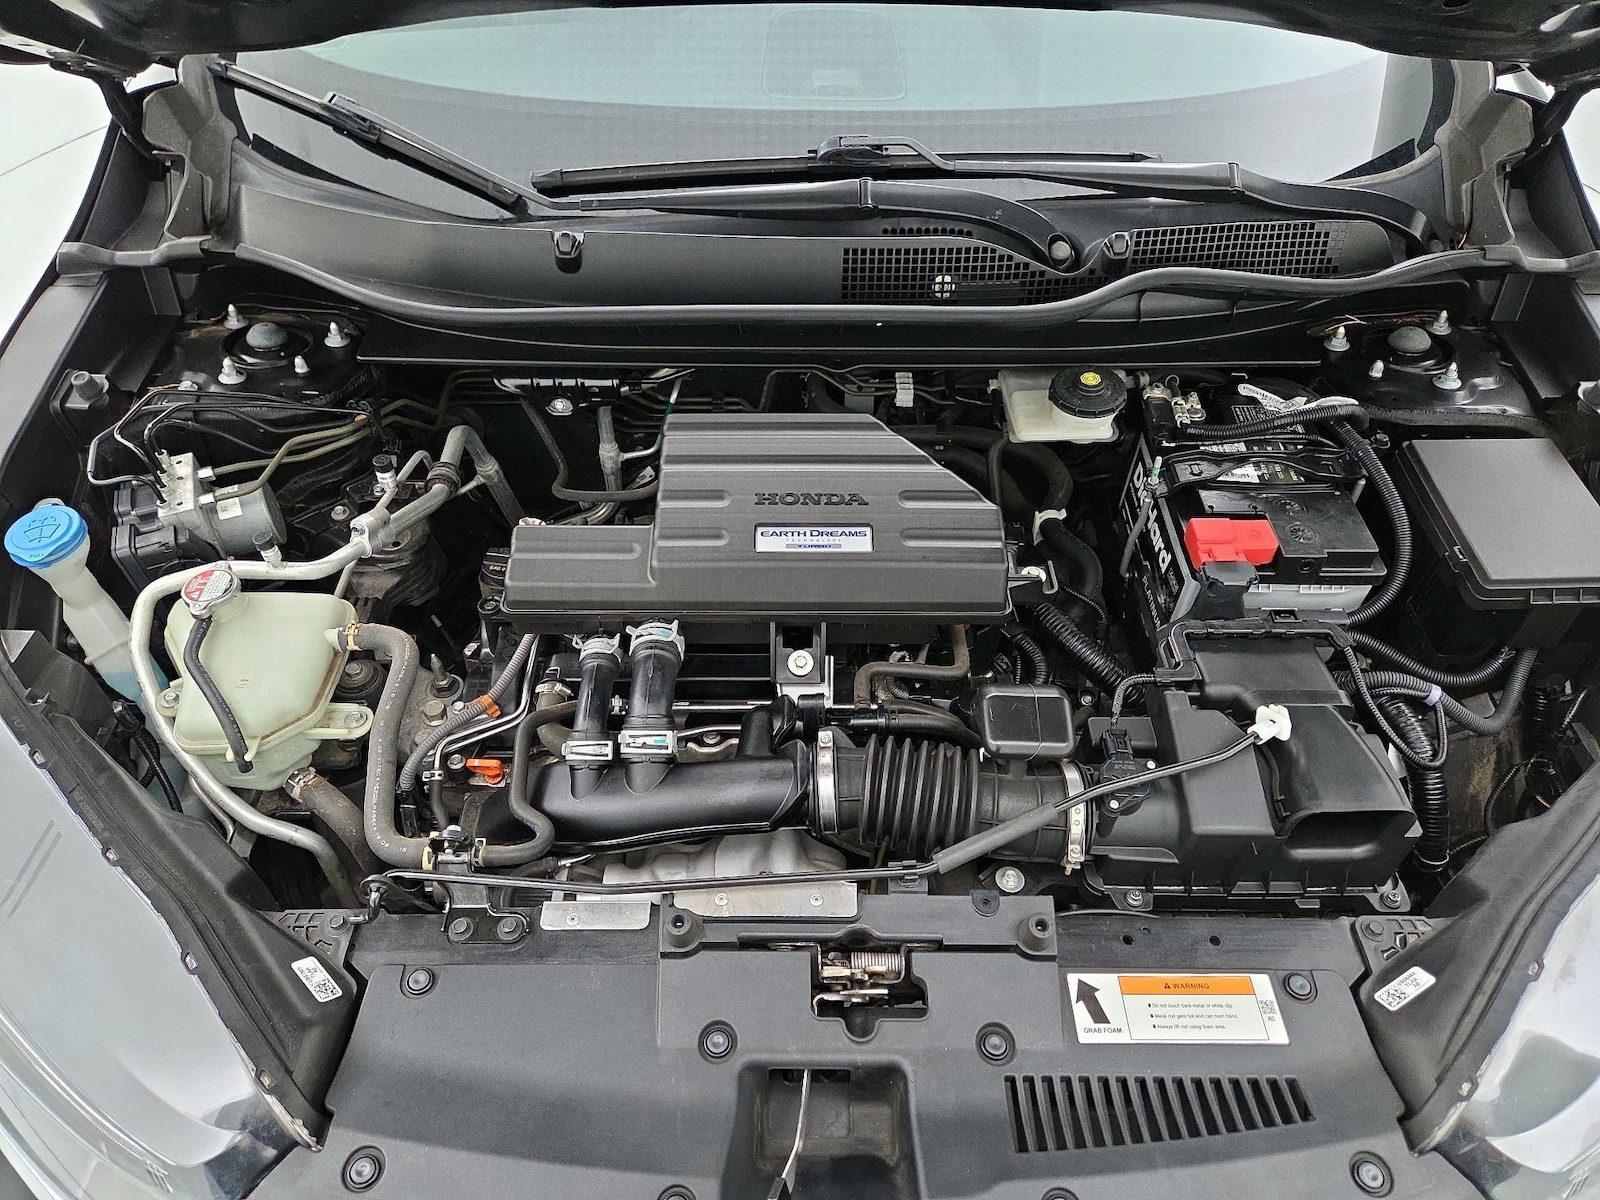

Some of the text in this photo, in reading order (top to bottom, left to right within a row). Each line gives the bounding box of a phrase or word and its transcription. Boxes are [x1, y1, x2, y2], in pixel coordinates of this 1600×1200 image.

[754, 492, 869, 506] HONDA
[760, 529, 868, 538] EARTH DREAMS
[1172, 982, 1210, 990] WARNING
